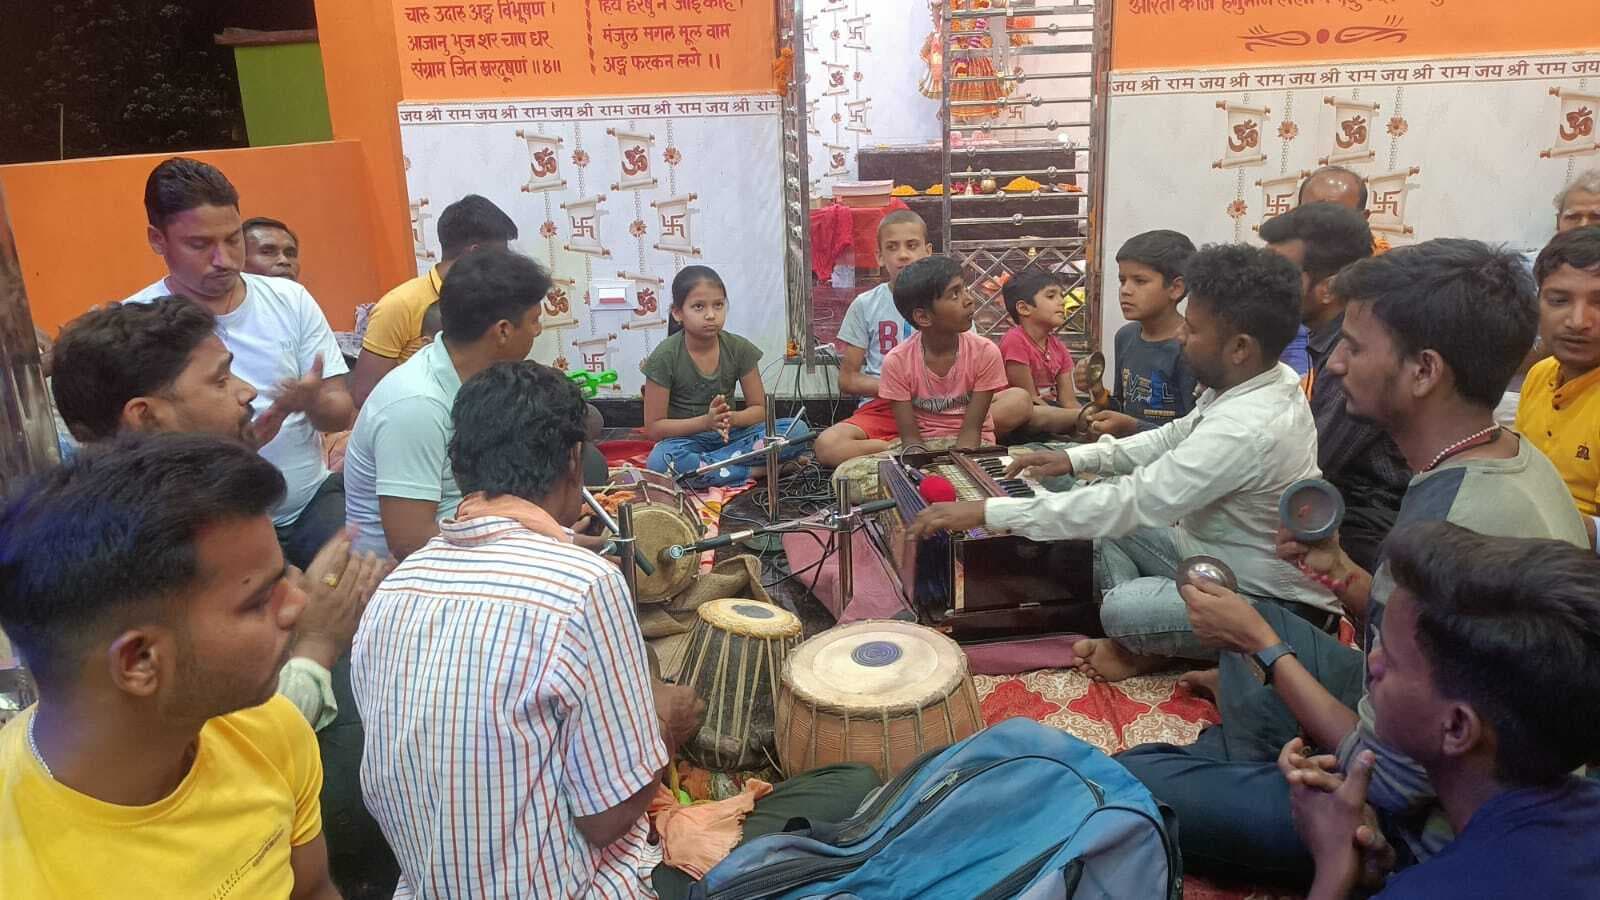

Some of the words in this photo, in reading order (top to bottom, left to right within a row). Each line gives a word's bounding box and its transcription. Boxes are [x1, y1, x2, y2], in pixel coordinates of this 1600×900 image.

[1112, 80, 1137, 93] जय
[1140, 76, 1160, 91] श्री
[1165, 78, 1194, 90] राम
[1199, 76, 1226, 89] जय
[1230, 72, 1250, 88] श्री
[1254, 74, 1284, 87] राम
[1289, 72, 1316, 85] जय
[1320, 68, 1341, 84] श्री
[1346, 69, 1377, 82] राम
[1381, 68, 1409, 81] जय
[1413, 64, 1434, 80] श्री
[1440, 66, 1470, 79] राम
[1475, 64, 1504, 77] जय
[1507, 60, 1530, 76] श्री
[1534, 62, 1567, 75] राम
[1572, 60, 1600, 73] जय
[400, 111, 423, 122] जय
[425, 107, 442, 122] श्री
[446, 109, 472, 121] राम
[475, 108, 498, 121] जय
[501, 105, 518, 120] श्री
[522, 106, 547, 119] राम
[551, 106, 574, 119] जय
[577, 103, 594, 118] श्री
[598, 105, 624, 117] राम
[628, 104, 651, 116] जय
[654, 100, 671, 115] श्री
[676, 102, 702, 114] राम
[705, 101, 729, 114] जय
[732, 98, 750, 113] श्री
